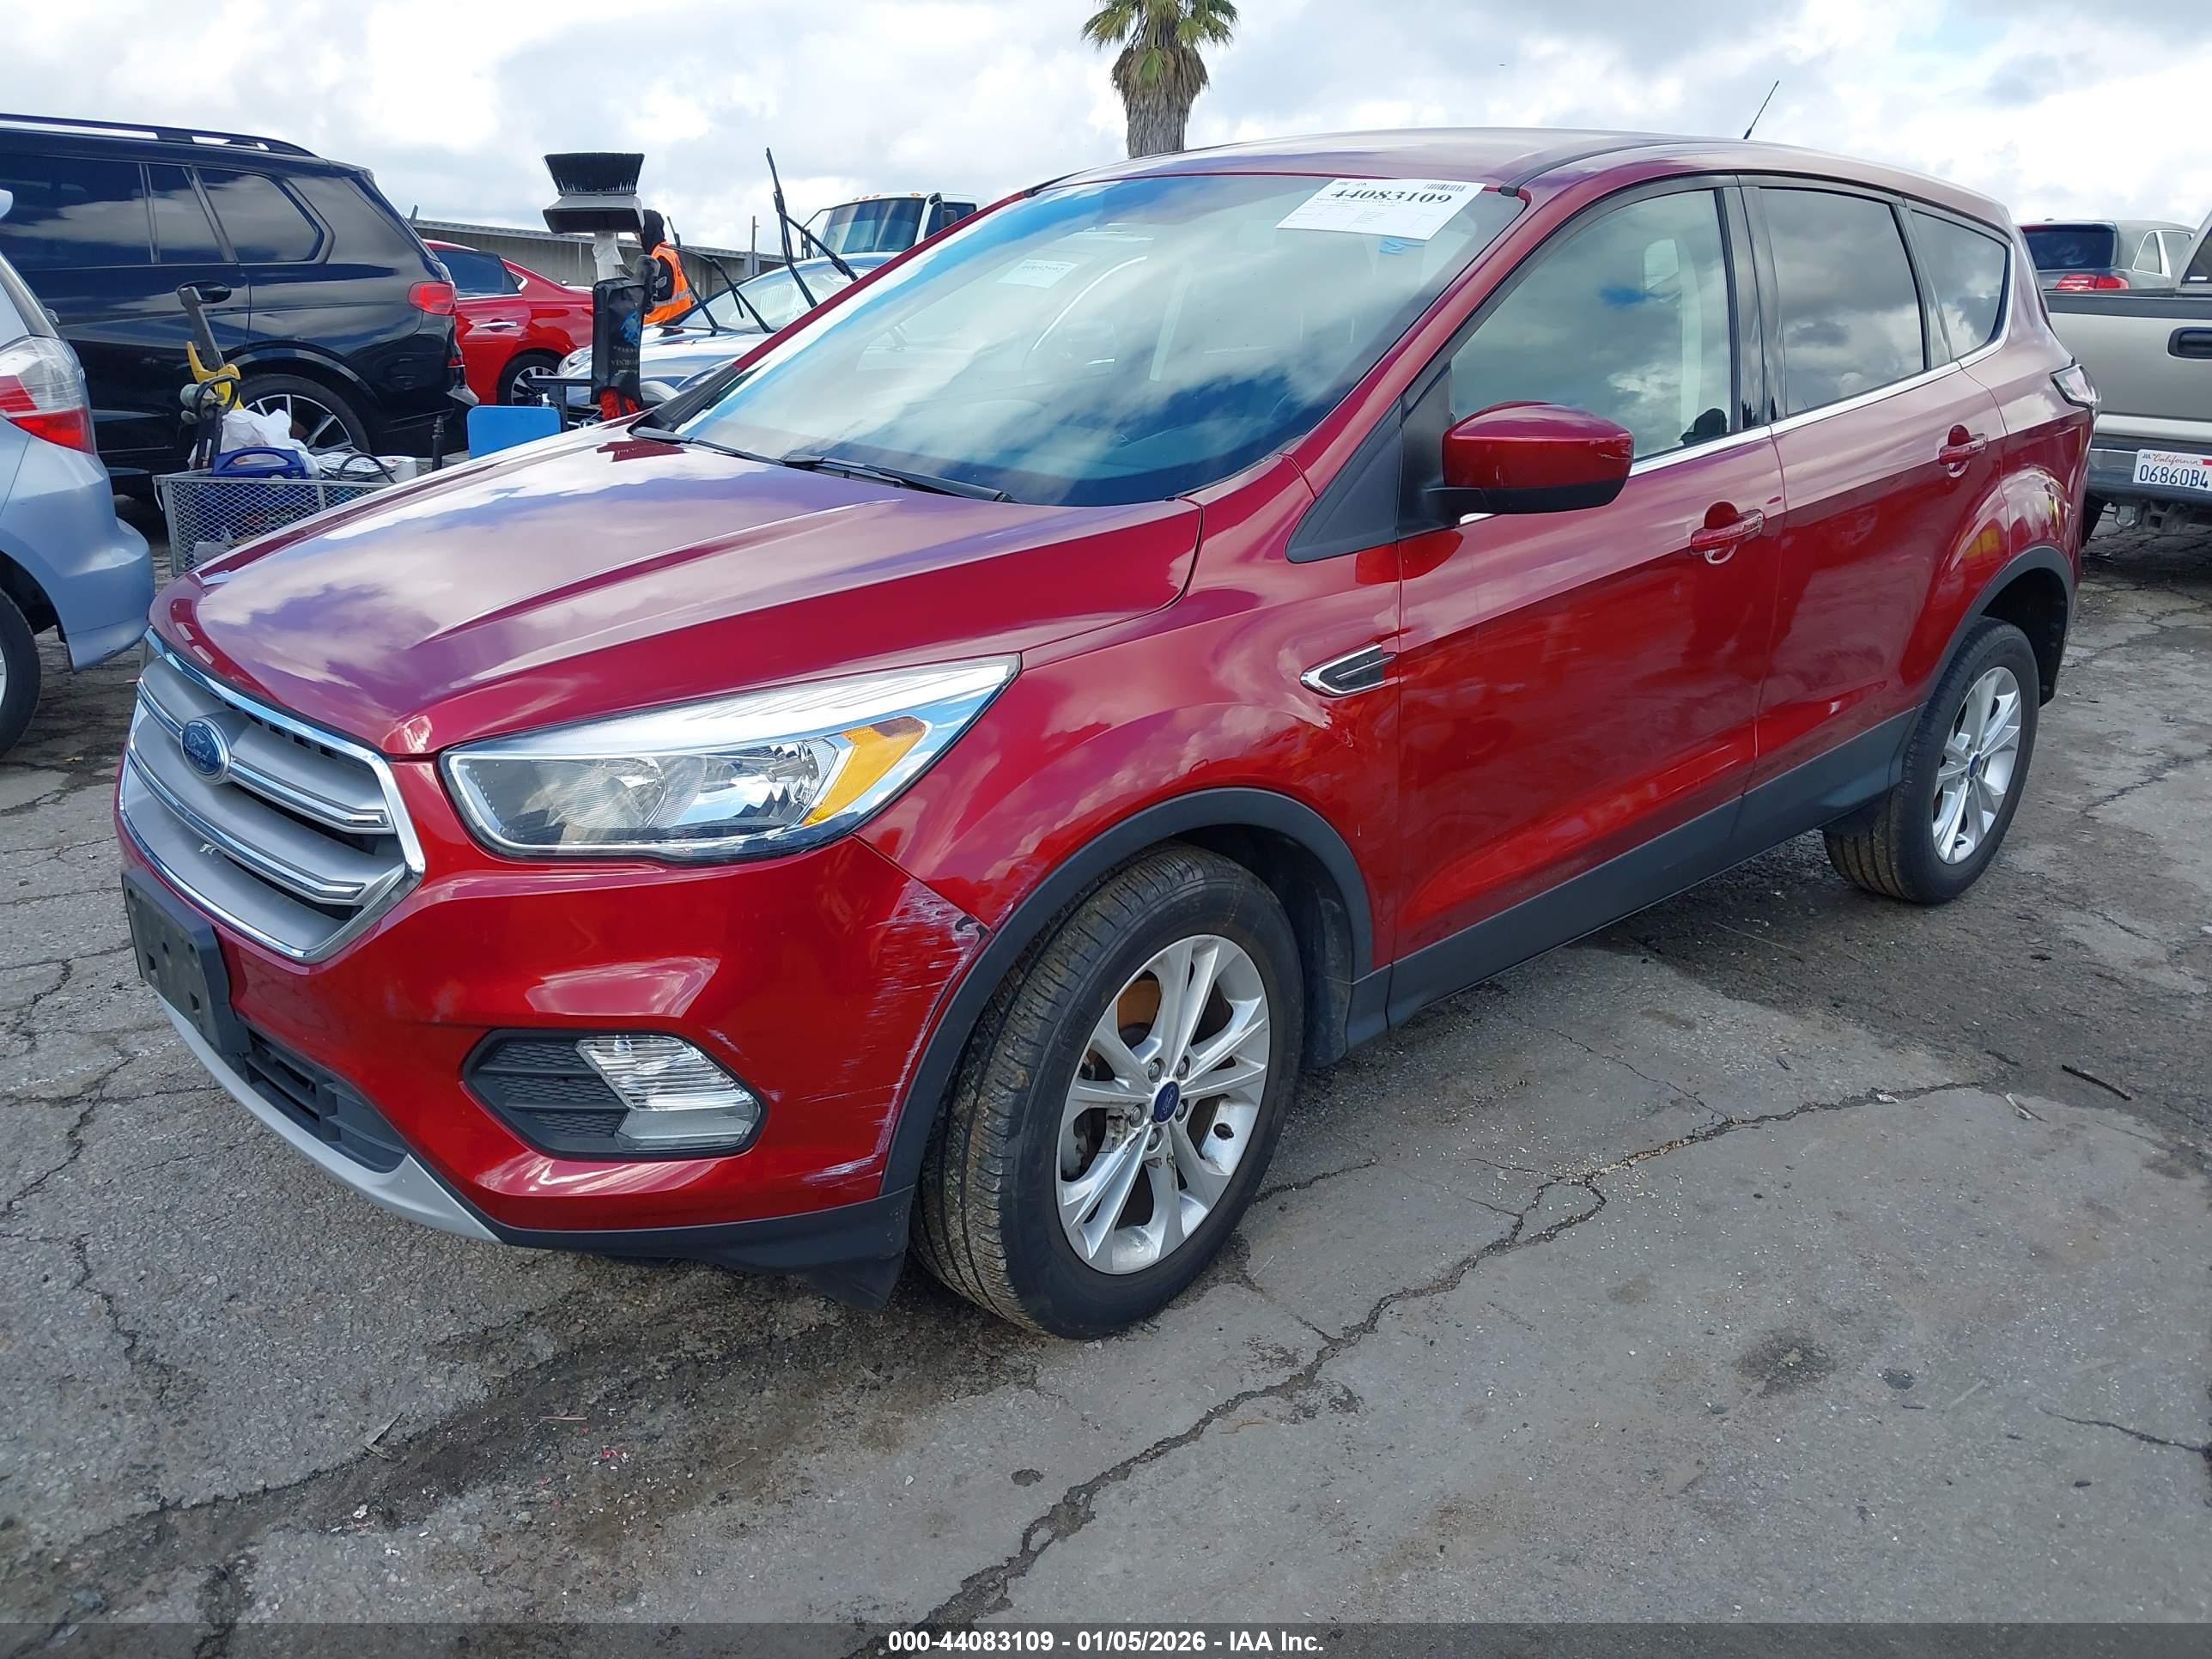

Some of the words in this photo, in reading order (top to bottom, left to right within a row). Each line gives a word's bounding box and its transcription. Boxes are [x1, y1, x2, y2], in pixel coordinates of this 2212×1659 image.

[1331, 188, 1453, 204] 44083109
[2153, 453, 2201, 465] California
[2139, 465, 2209, 488] 06860B4
